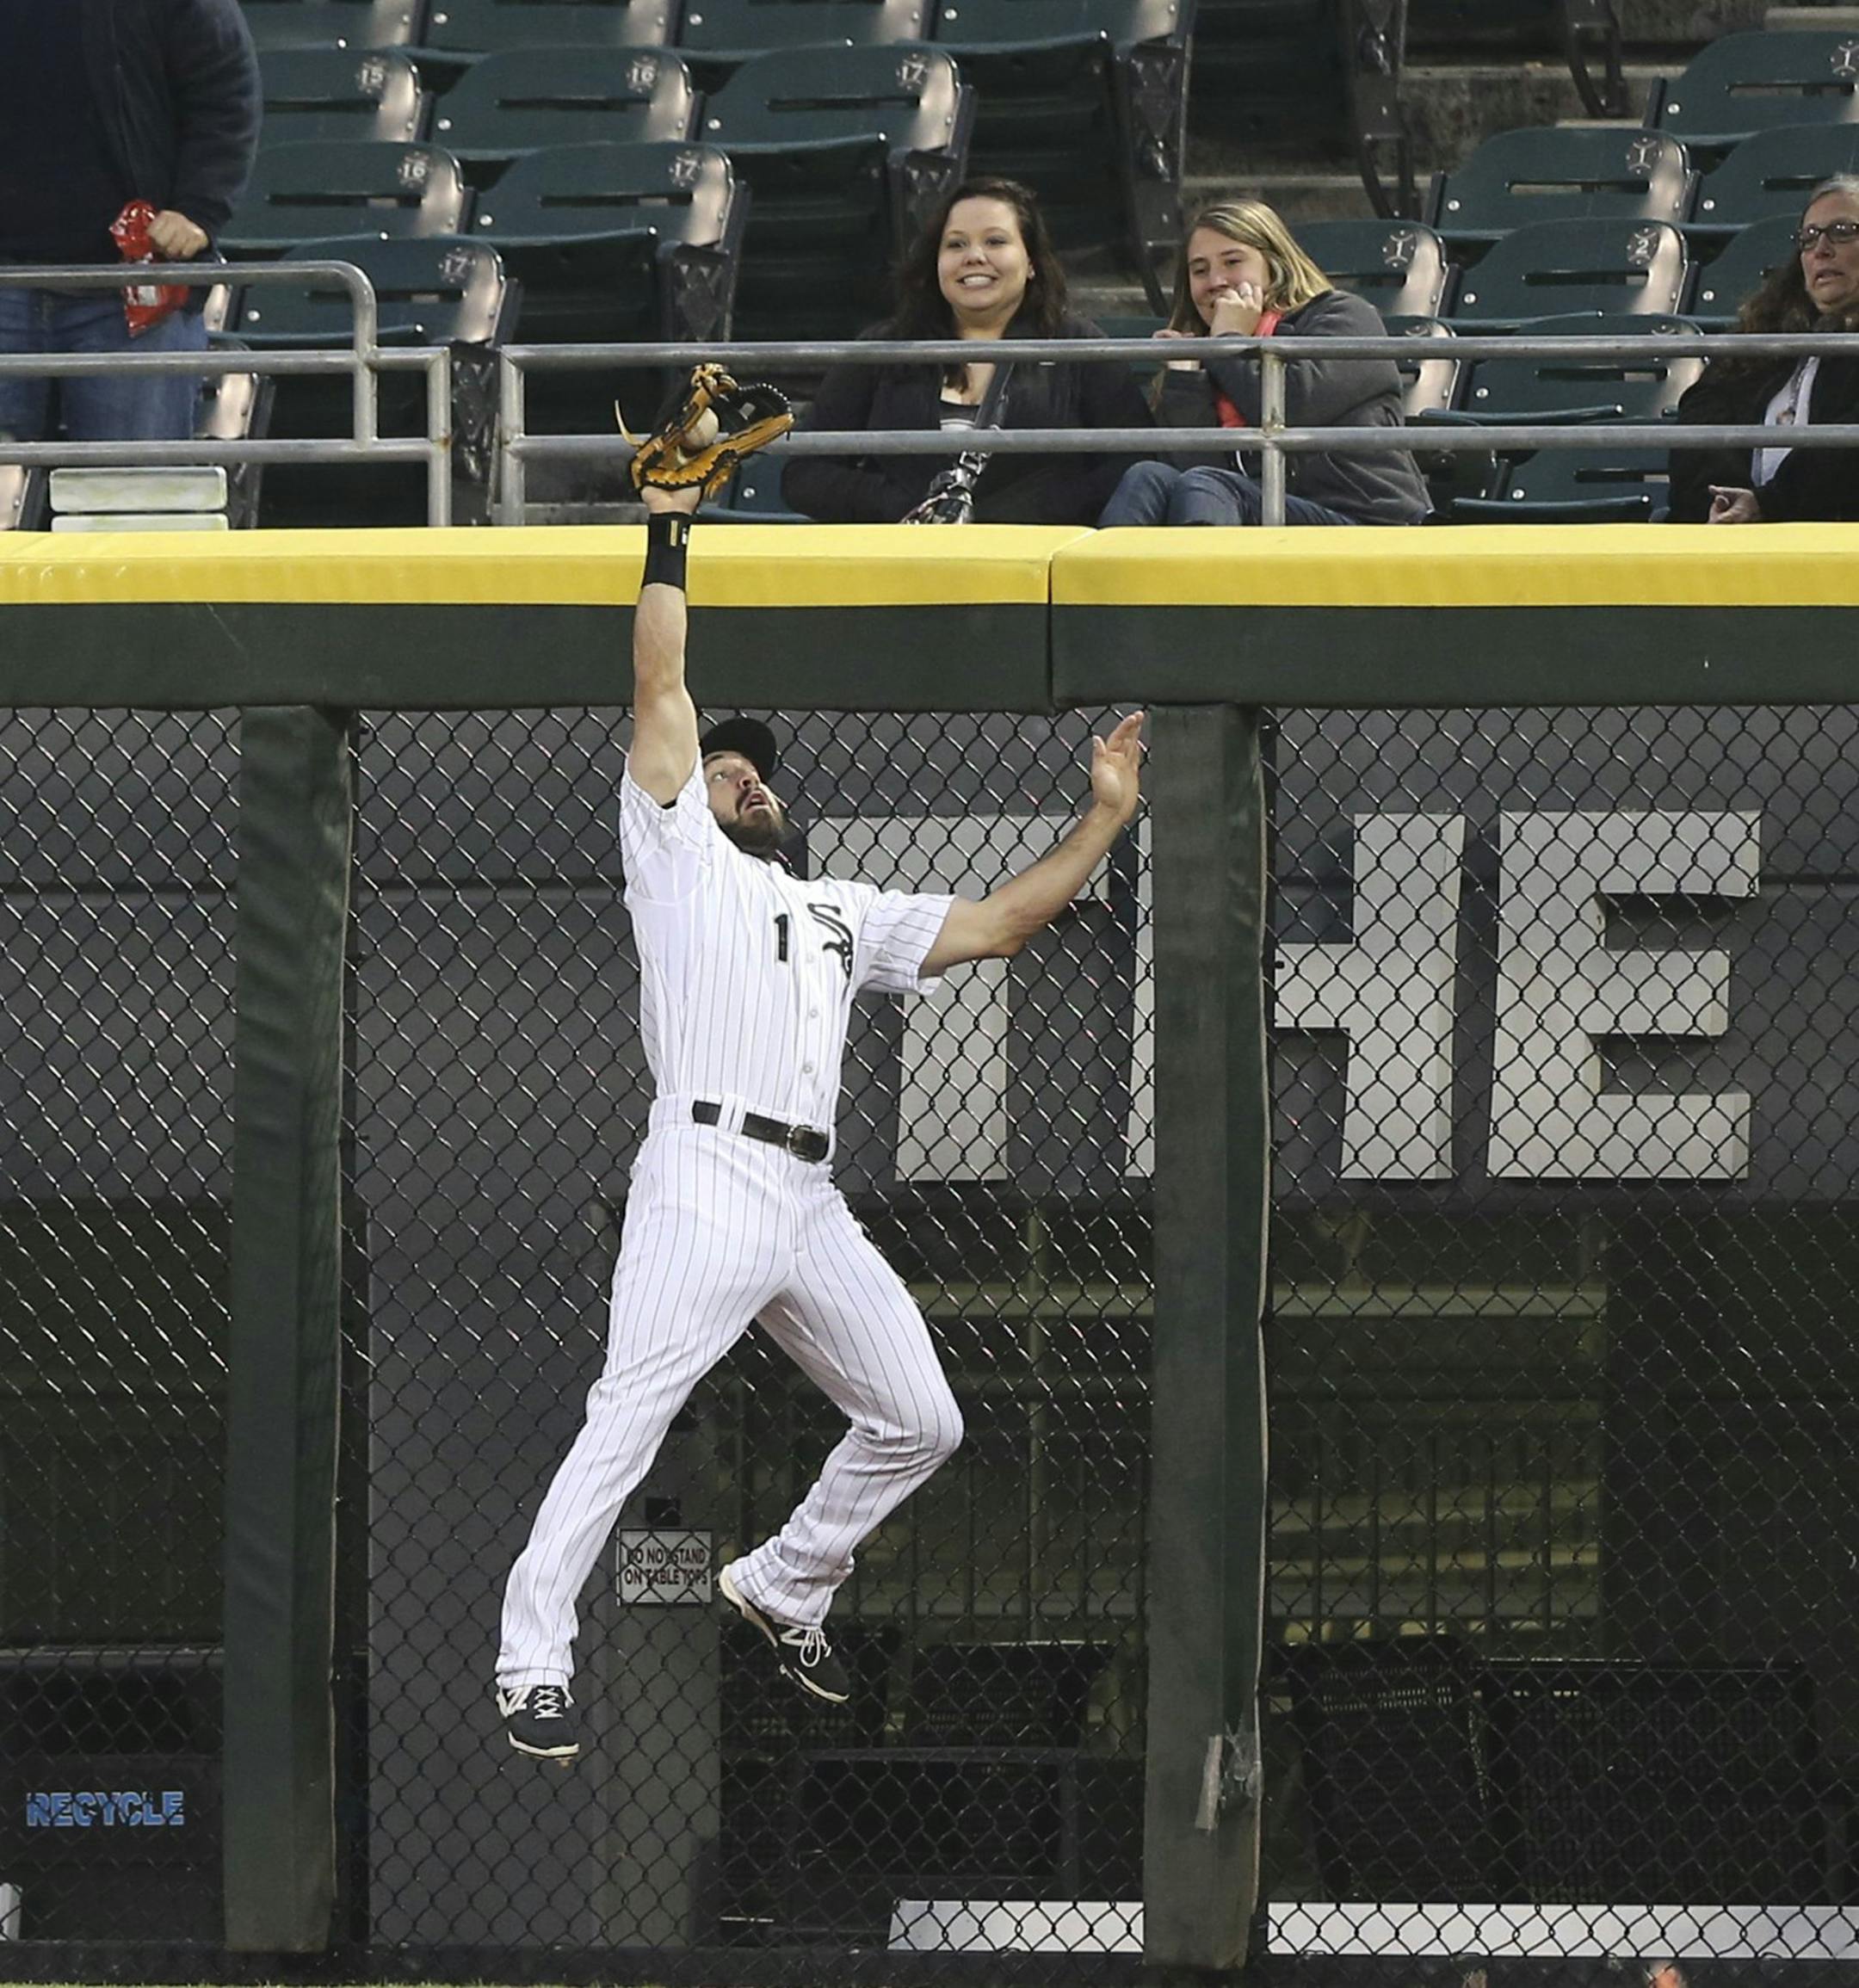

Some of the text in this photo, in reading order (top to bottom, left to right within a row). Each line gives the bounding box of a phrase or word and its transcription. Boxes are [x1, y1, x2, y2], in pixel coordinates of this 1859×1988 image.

[361, 67, 384, 83] 15
[632, 66, 655, 83] 16
[902, 64, 925, 81] 17
[403, 162, 426, 178] 16
[676, 161, 698, 177] 17
[1635, 238, 1649, 255] 2
[445, 257, 467, 274] 17
[775, 914, 787, 962] 1
[808, 811, 1761, 1182] THE
[647, 1548, 670, 1564] NO
[671, 1548, 707, 1564] STAND
[625, 1569, 707, 1584] ON TABLE TOPS
[27, 1791, 184, 1826] RECYCLE
